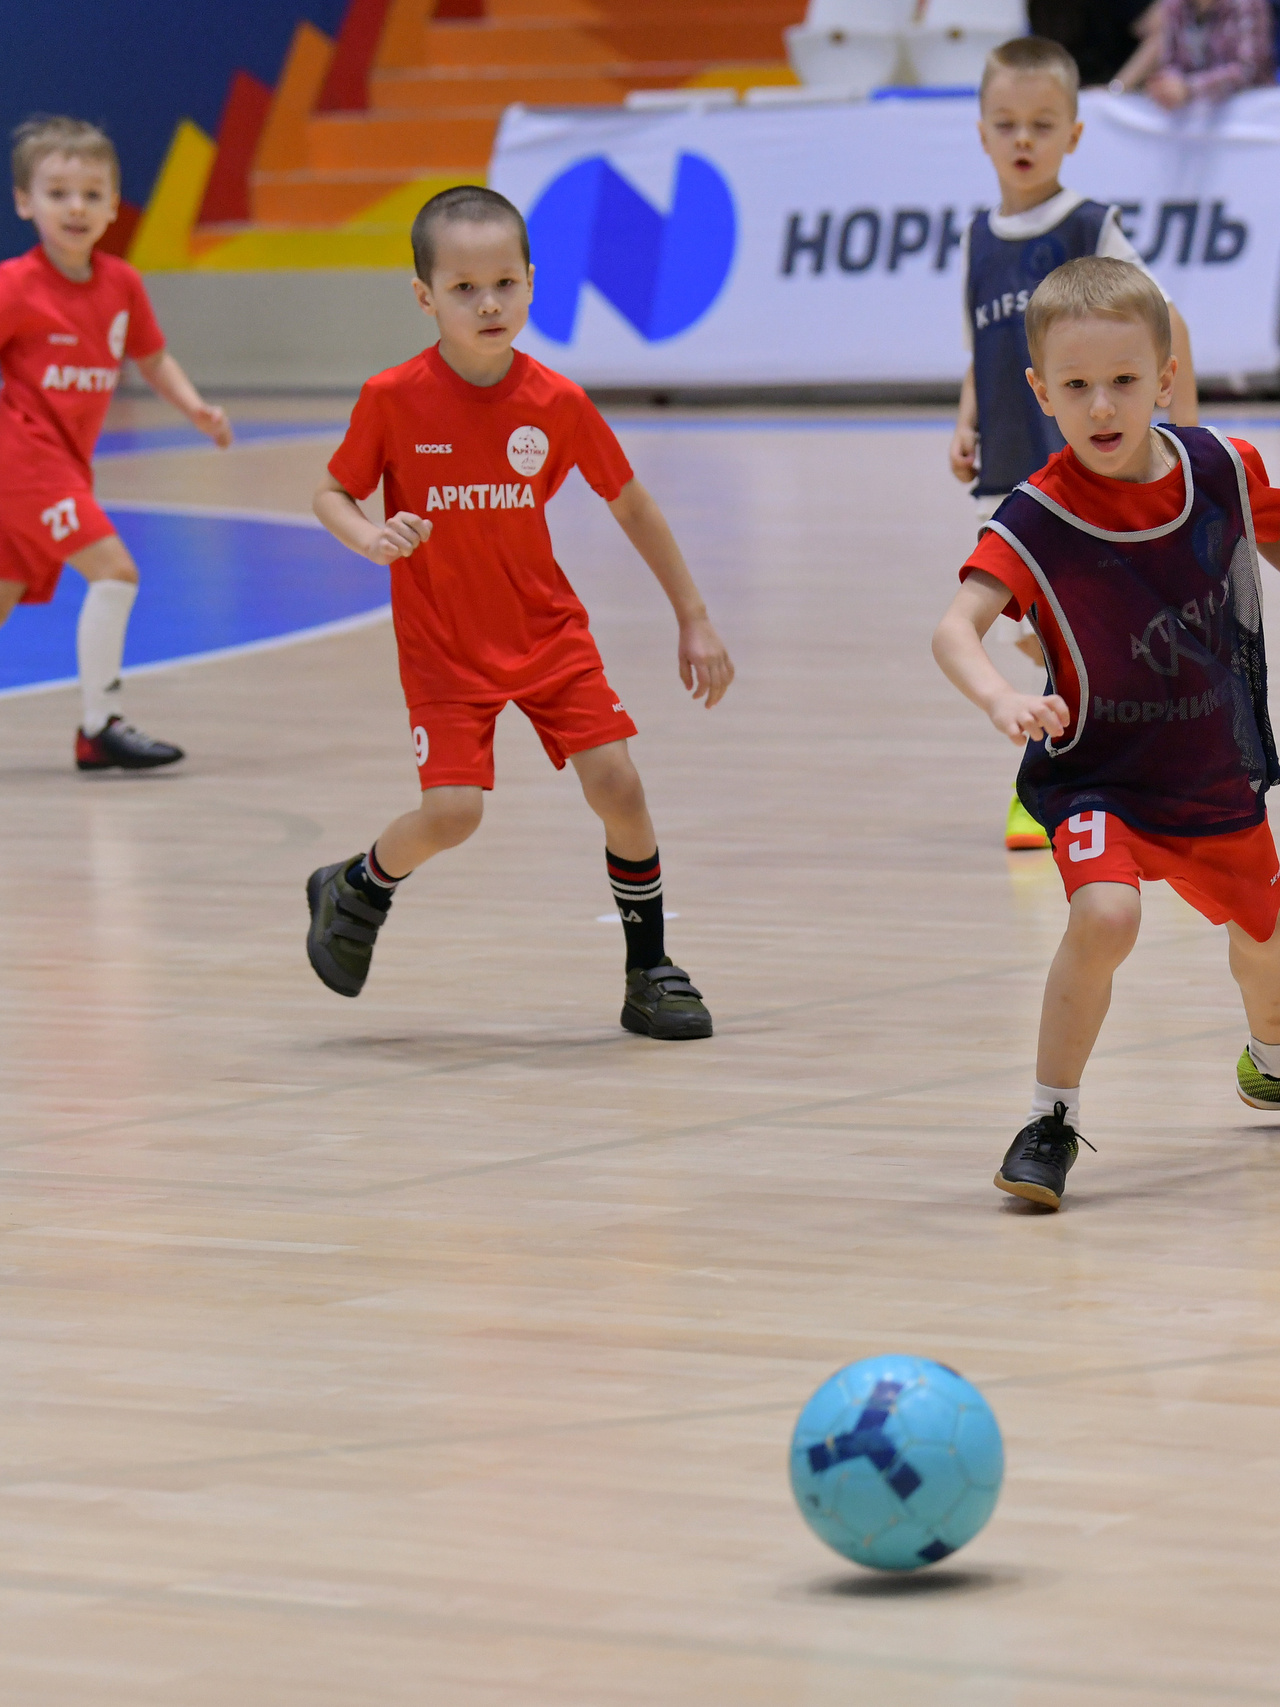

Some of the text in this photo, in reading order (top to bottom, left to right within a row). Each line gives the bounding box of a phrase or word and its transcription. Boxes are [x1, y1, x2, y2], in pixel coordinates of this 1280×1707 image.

[41, 364, 119, 392] АРКТИ
[415, 443, 453, 454] KODES
[426, 483, 535, 512] АРКТИКА
[41, 496, 80, 542] 27
[1093, 687, 1222, 724] НОРНИК
[413, 725, 429, 767] 9
[1068, 809, 1106, 863] 9
